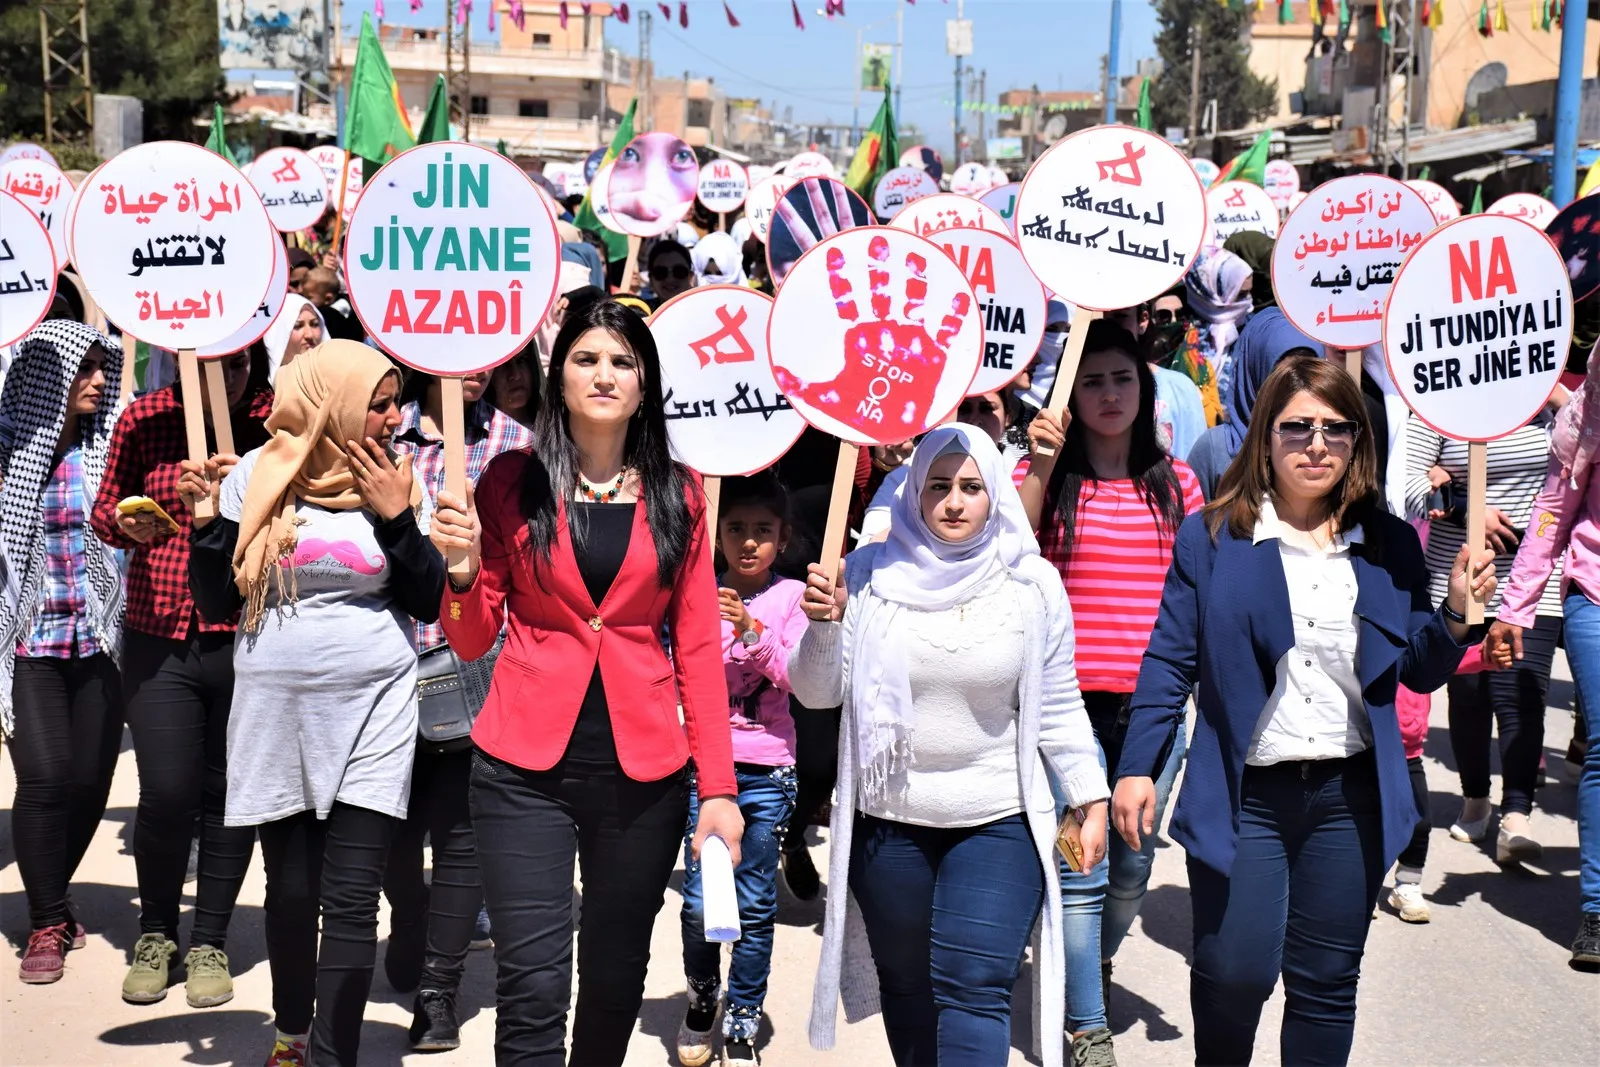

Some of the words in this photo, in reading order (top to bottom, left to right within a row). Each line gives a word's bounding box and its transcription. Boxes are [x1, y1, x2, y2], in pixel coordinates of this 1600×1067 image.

[714, 164, 732, 179] NA
[99, 183, 169, 225] حياة
[173, 177, 242, 222] المرأة
[1377, 191, 1403, 219] لن
[1310, 264, 1353, 295] فيه
[1448, 235, 1518, 305] NA
[134, 289, 224, 331] الحياة
[381, 279, 525, 335] AZADÎ
[1315, 299, 1382, 327] نساء
[861, 352, 914, 384] STOP
[982, 341, 1015, 370] RE
[1413, 357, 1463, 395] SER
[1527, 339, 1557, 375] RE
[856, 399, 884, 424] NA
[297, 553, 354, 569] Serious
